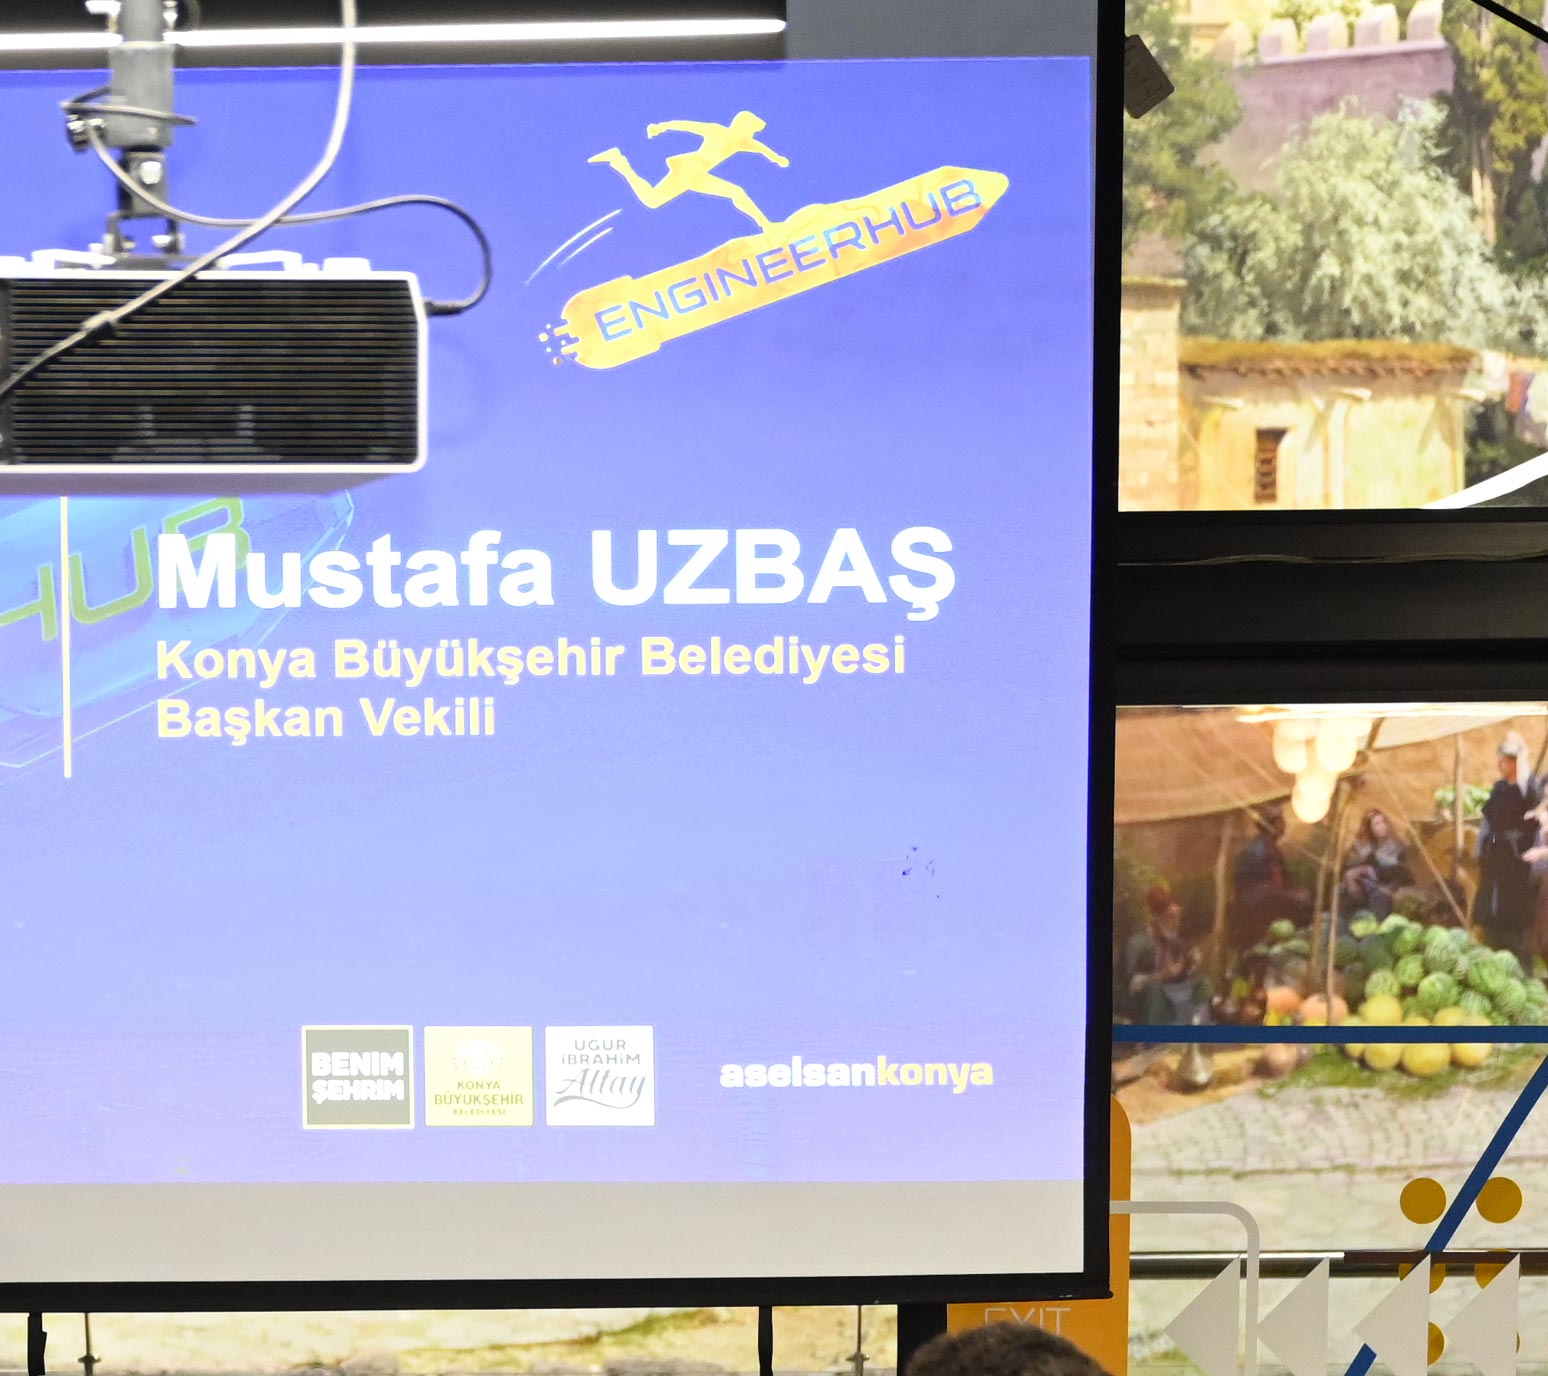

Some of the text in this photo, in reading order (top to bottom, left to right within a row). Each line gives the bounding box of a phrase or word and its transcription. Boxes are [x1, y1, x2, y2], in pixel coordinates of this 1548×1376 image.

[594, 179, 982, 342] ENGINEERHUB
[157, 526, 957, 621] Mustafa UZBAŞ
[156, 635, 906, 689] Konya Büyükşehir Belediyesi
[156, 696, 496, 746] Başkan Vekili
[457, 1081, 501, 1090] KONYA
[554, 1068, 647, 1109] Altay
[719, 1055, 994, 1095] aselsankonya
